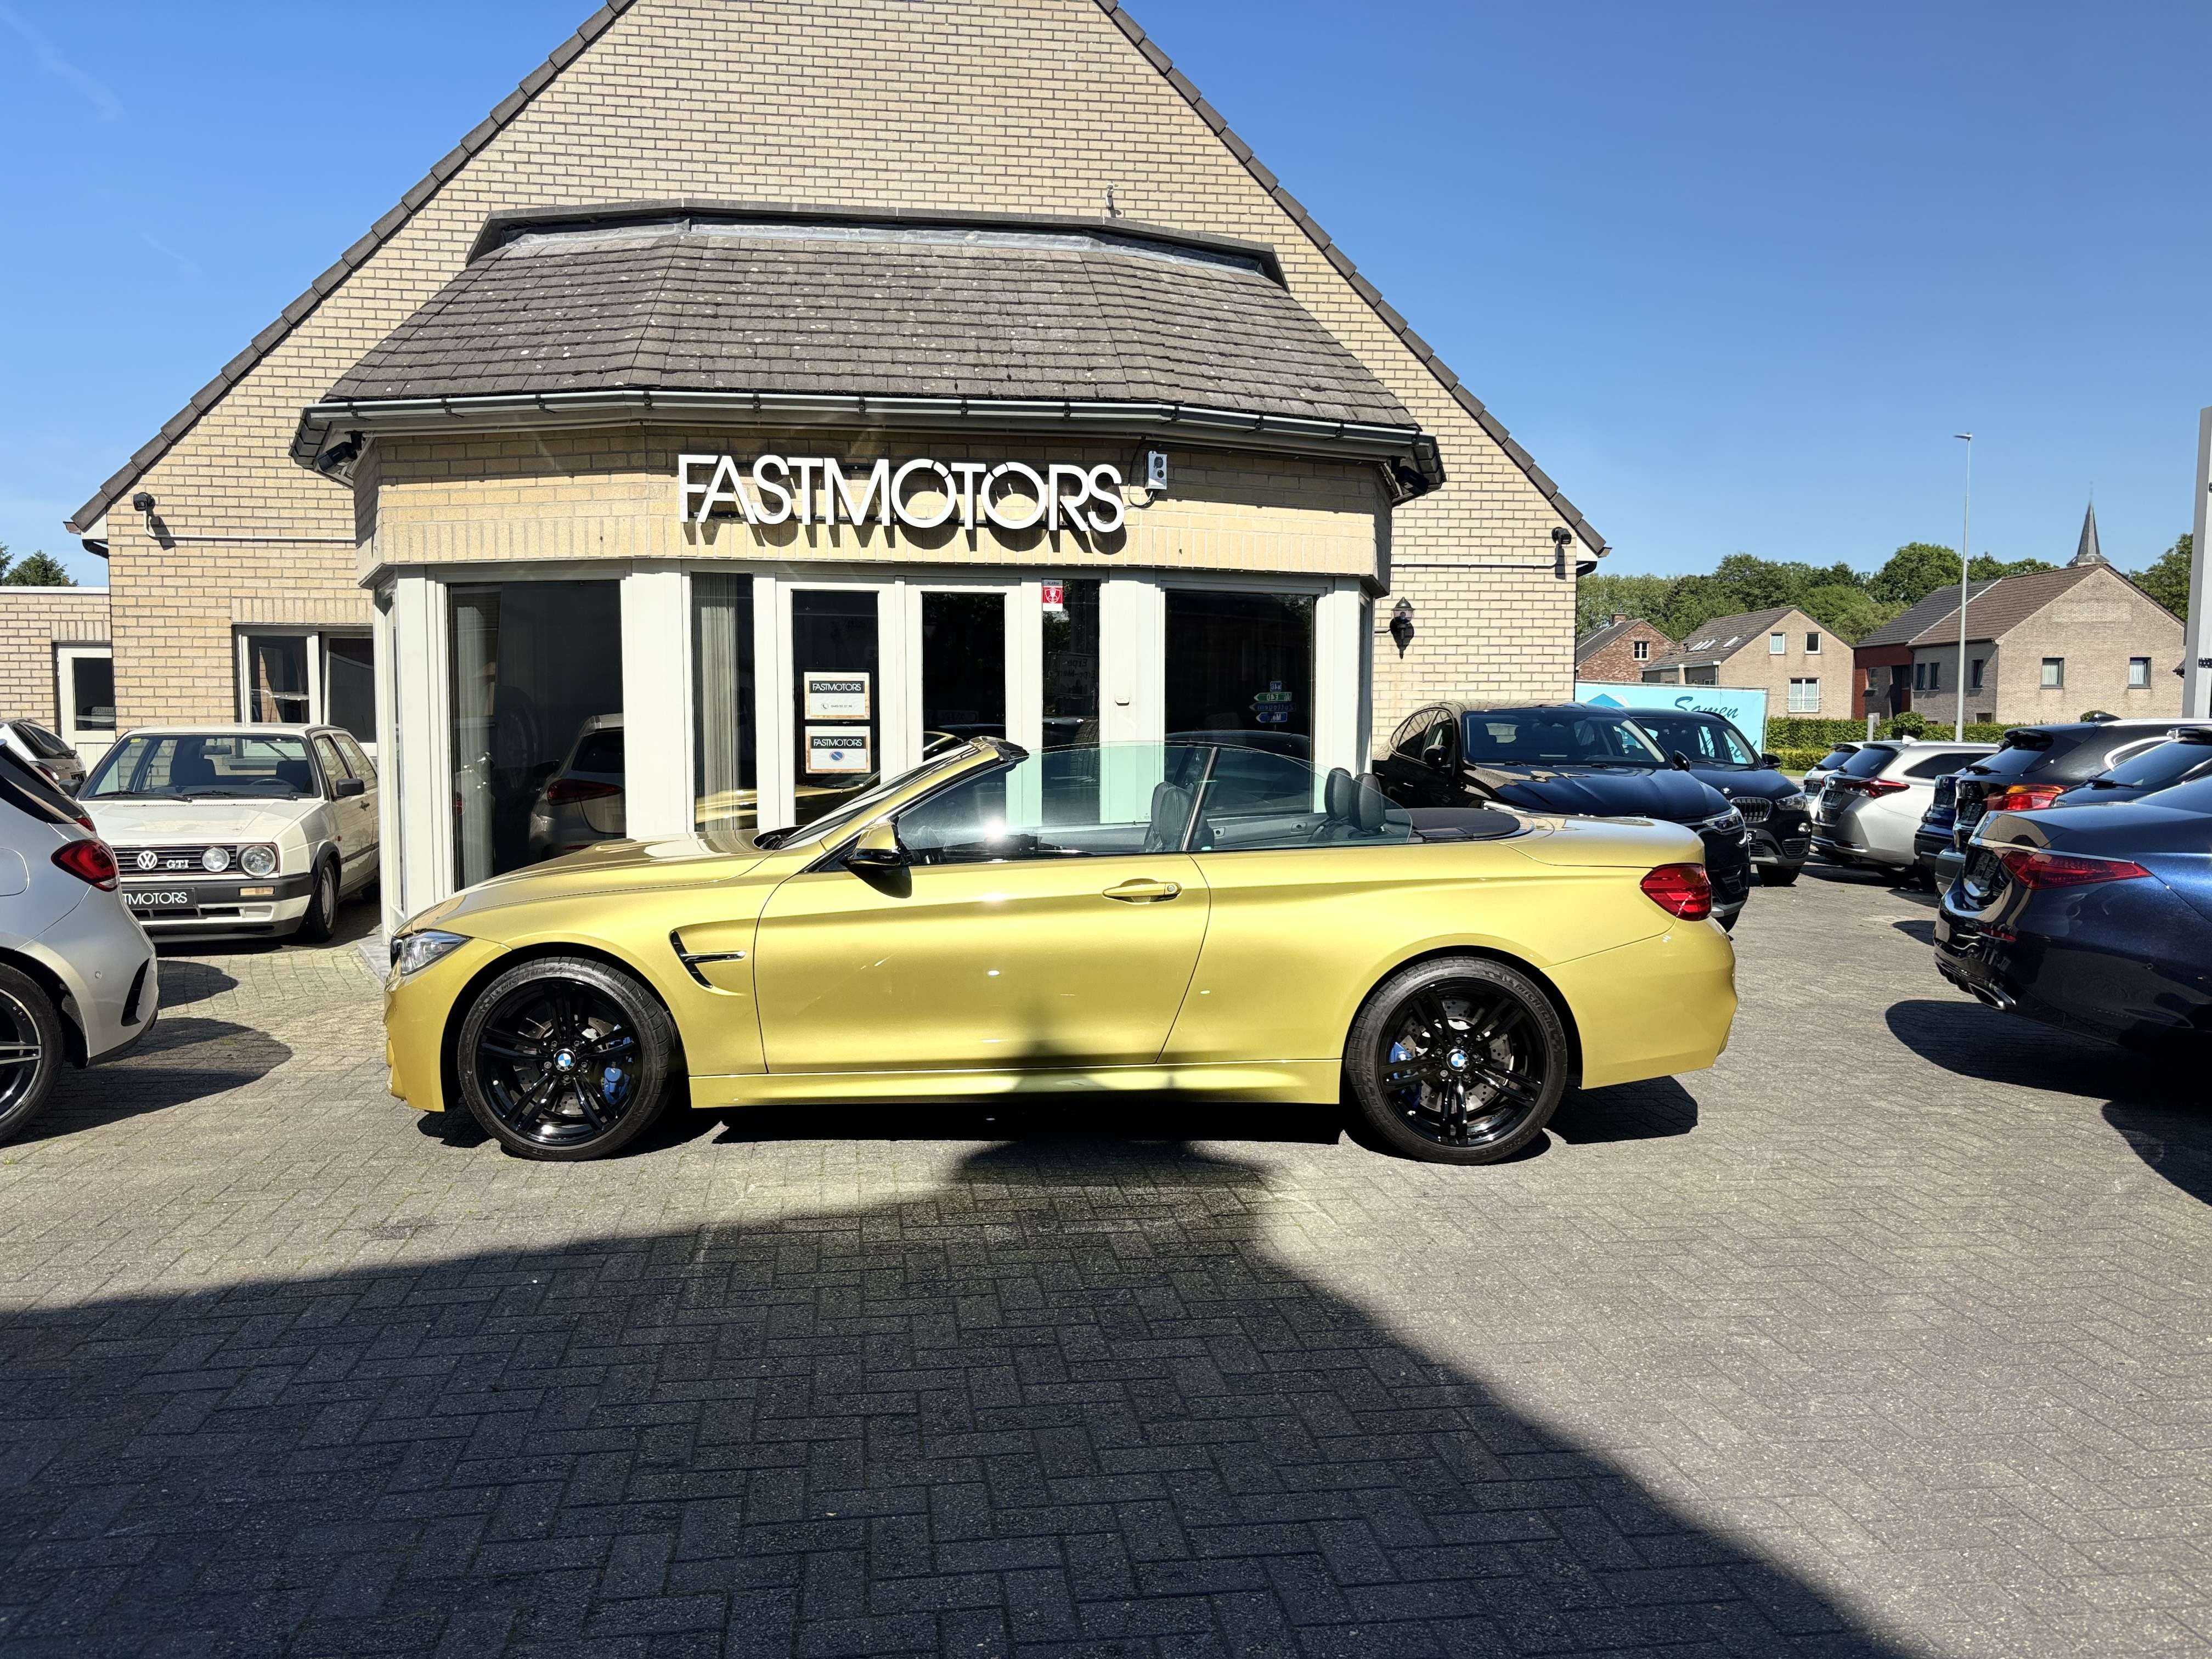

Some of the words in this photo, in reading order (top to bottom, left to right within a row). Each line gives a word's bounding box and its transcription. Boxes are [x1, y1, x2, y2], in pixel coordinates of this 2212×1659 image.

[678, 454, 1125, 533] FASTMOTORS
[812, 683, 861, 691] FASTMOTORS
[1675, 696, 1739, 719] Samen
[814, 738, 862, 747] FASTMOTORS
[166, 860, 189, 868] GTI
[122, 891, 188, 905] TMOTORS
